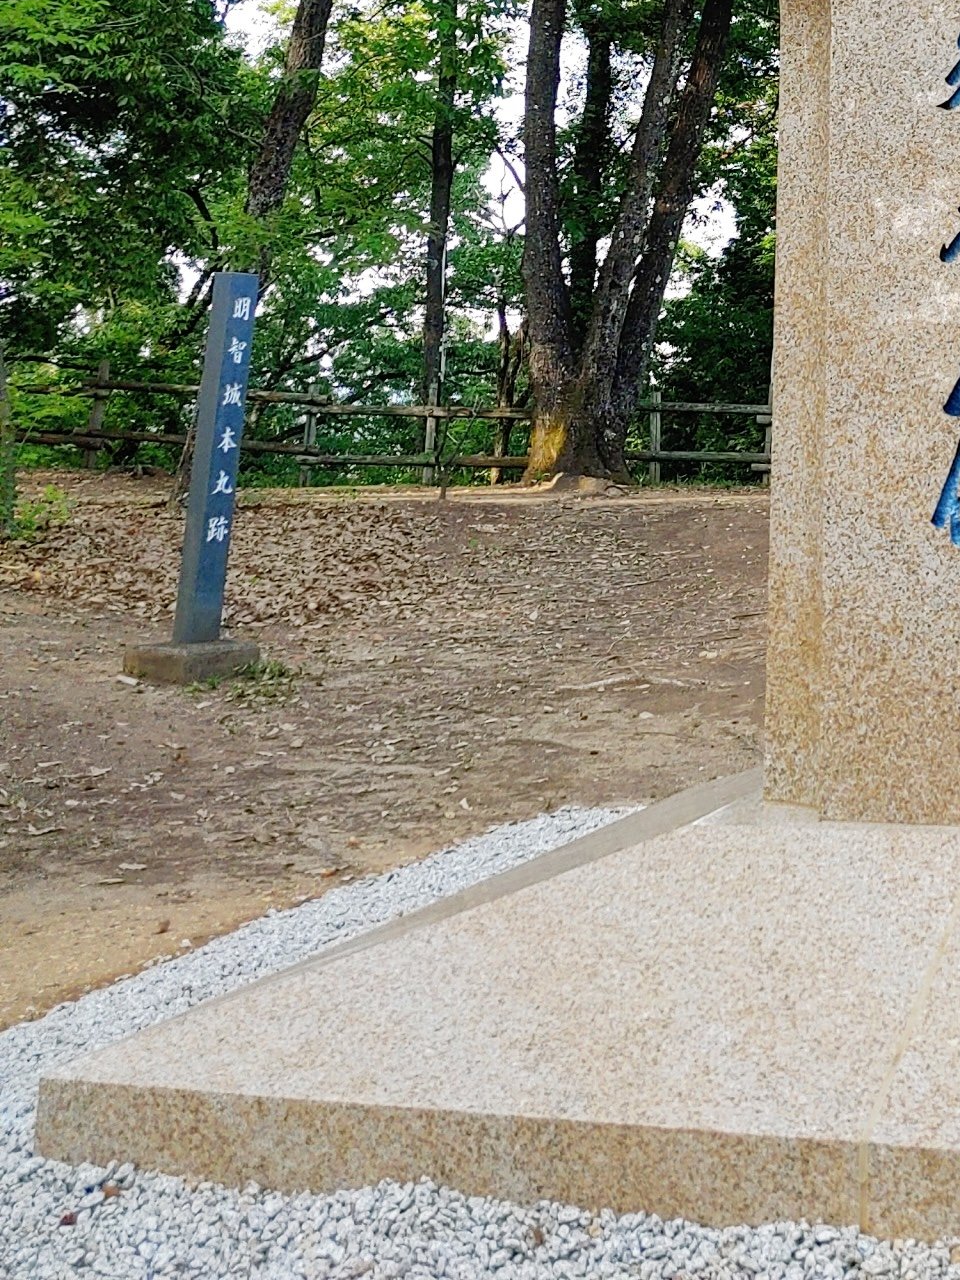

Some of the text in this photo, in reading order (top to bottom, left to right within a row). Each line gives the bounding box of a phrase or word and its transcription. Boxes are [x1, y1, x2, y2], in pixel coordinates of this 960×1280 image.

[206, 297, 251, 542] 明智城本丸跡
